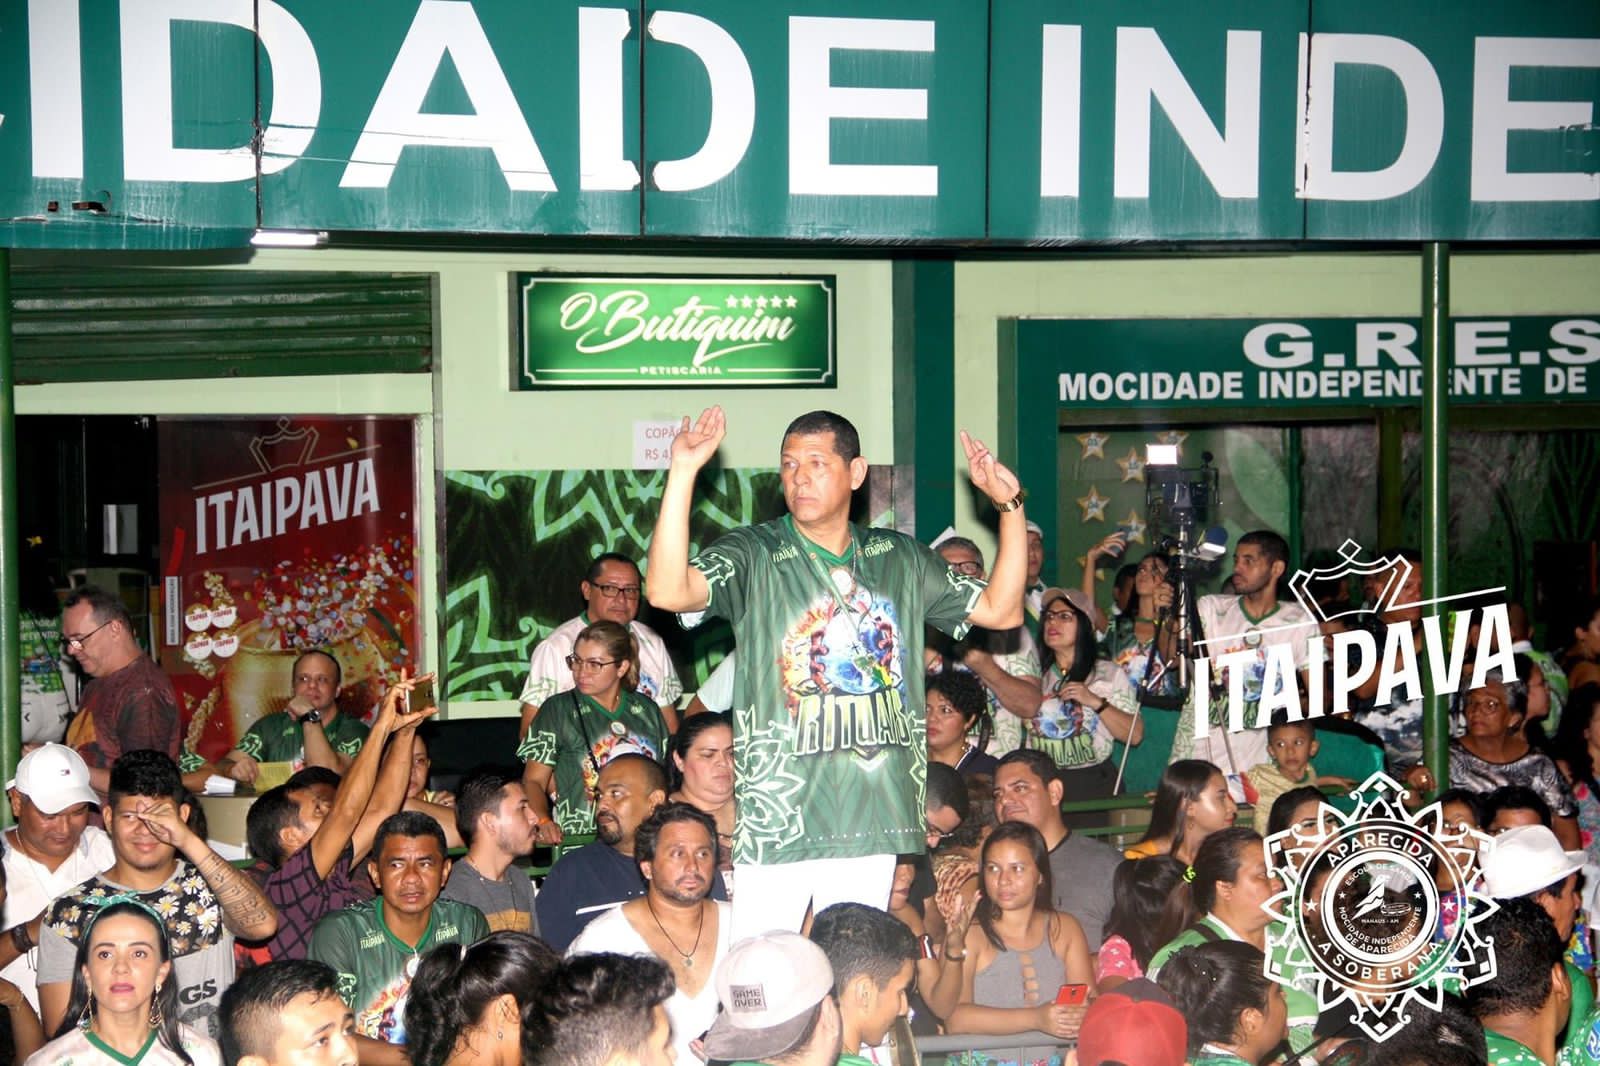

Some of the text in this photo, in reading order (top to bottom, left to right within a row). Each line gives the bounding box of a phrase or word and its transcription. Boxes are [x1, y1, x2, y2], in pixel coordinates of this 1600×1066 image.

[0, 0, 1600, 202] IDADE INDE
[560, 290, 796, 367] O Butiquim
[1243, 319, 1600, 368] G.RE.S
[639, 365, 722, 376] PETISCARIA
[1059, 367, 1586, 401] MOCIDADE INDEPENDNTE DE
[645, 425, 681, 439] COPÃ
[645, 448, 659, 460] R$
[194, 458, 381, 555] ITAIPAVA
[179, 977, 217, 1004] GS
[733, 990, 761, 998] GAME
[735, 999, 762, 1007] OVER
